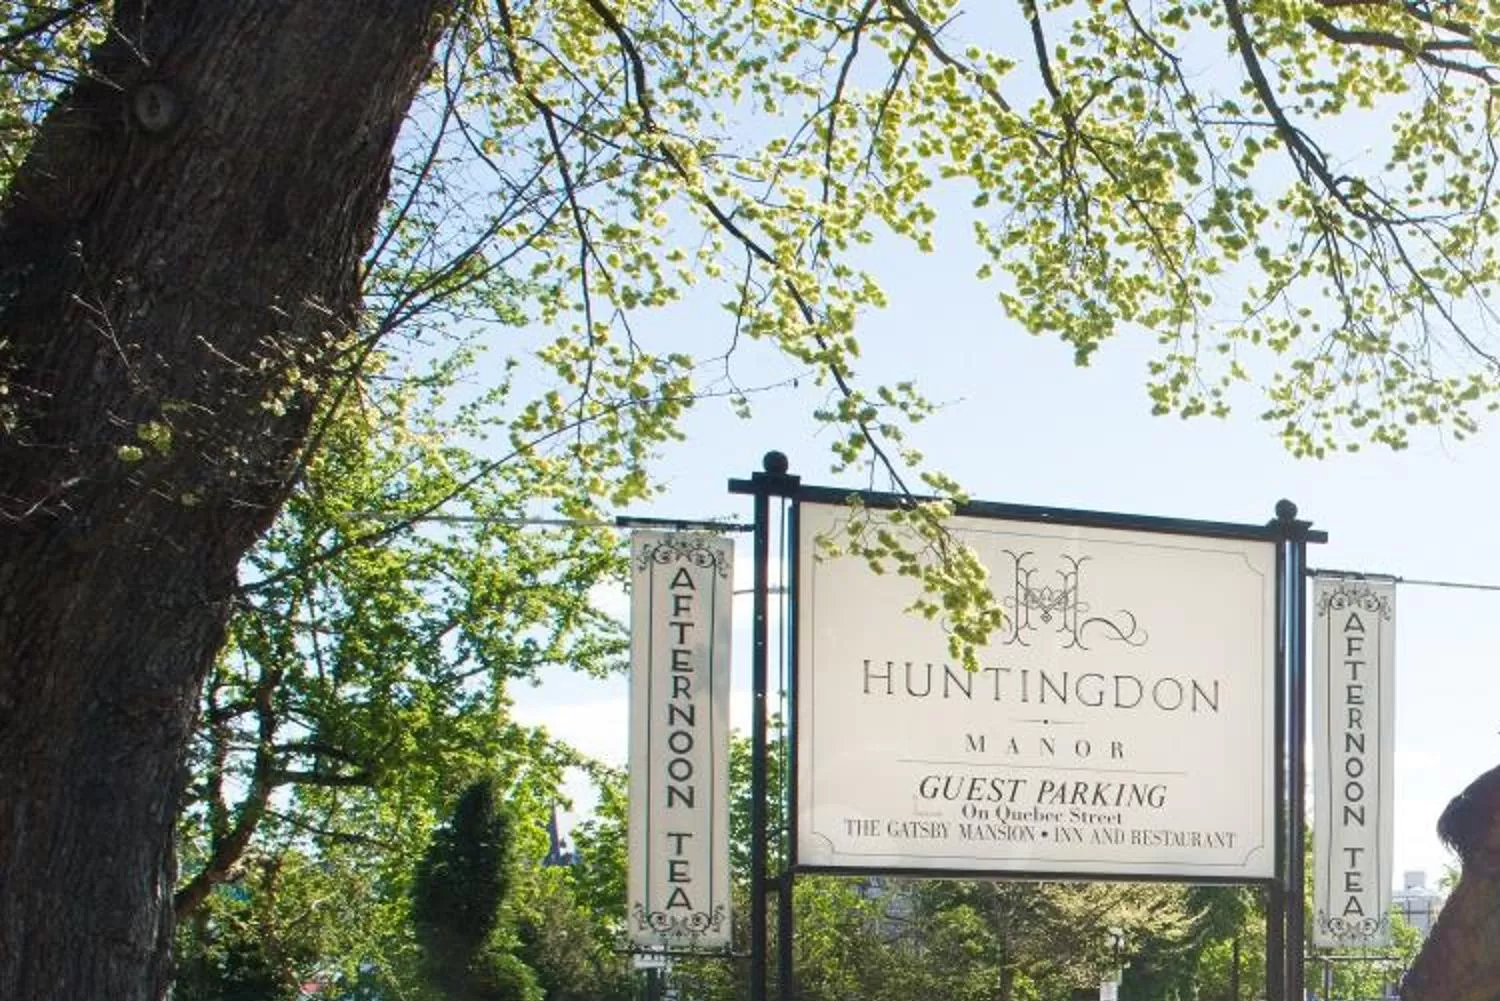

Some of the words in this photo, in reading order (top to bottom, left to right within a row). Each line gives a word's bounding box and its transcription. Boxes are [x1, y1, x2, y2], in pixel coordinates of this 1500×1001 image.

[667, 566, 696, 809] AFTERNOON
[862, 658, 1220, 713] HUNTINGDON
[965, 733, 1125, 760] MANOR
[1343, 611, 1366, 828] AFTERNOON
[919, 775, 1028, 803] GUEST
[1036, 779, 1168, 809] PARKING
[961, 803, 989, 820] On
[995, 804, 1063, 824] Quebec
[1069, 807, 1122, 825] Street
[843, 818, 881, 837] THE
[887, 820, 952, 839] GATSBY
[959, 823, 1036, 841] MANSION
[1055, 826, 1084, 843] INN
[1090, 828, 1126, 845] AND
[1131, 829, 1237, 849] RESTAURANT
[666, 832, 694, 911] TEA
[1343, 847, 1365, 917] TEA
